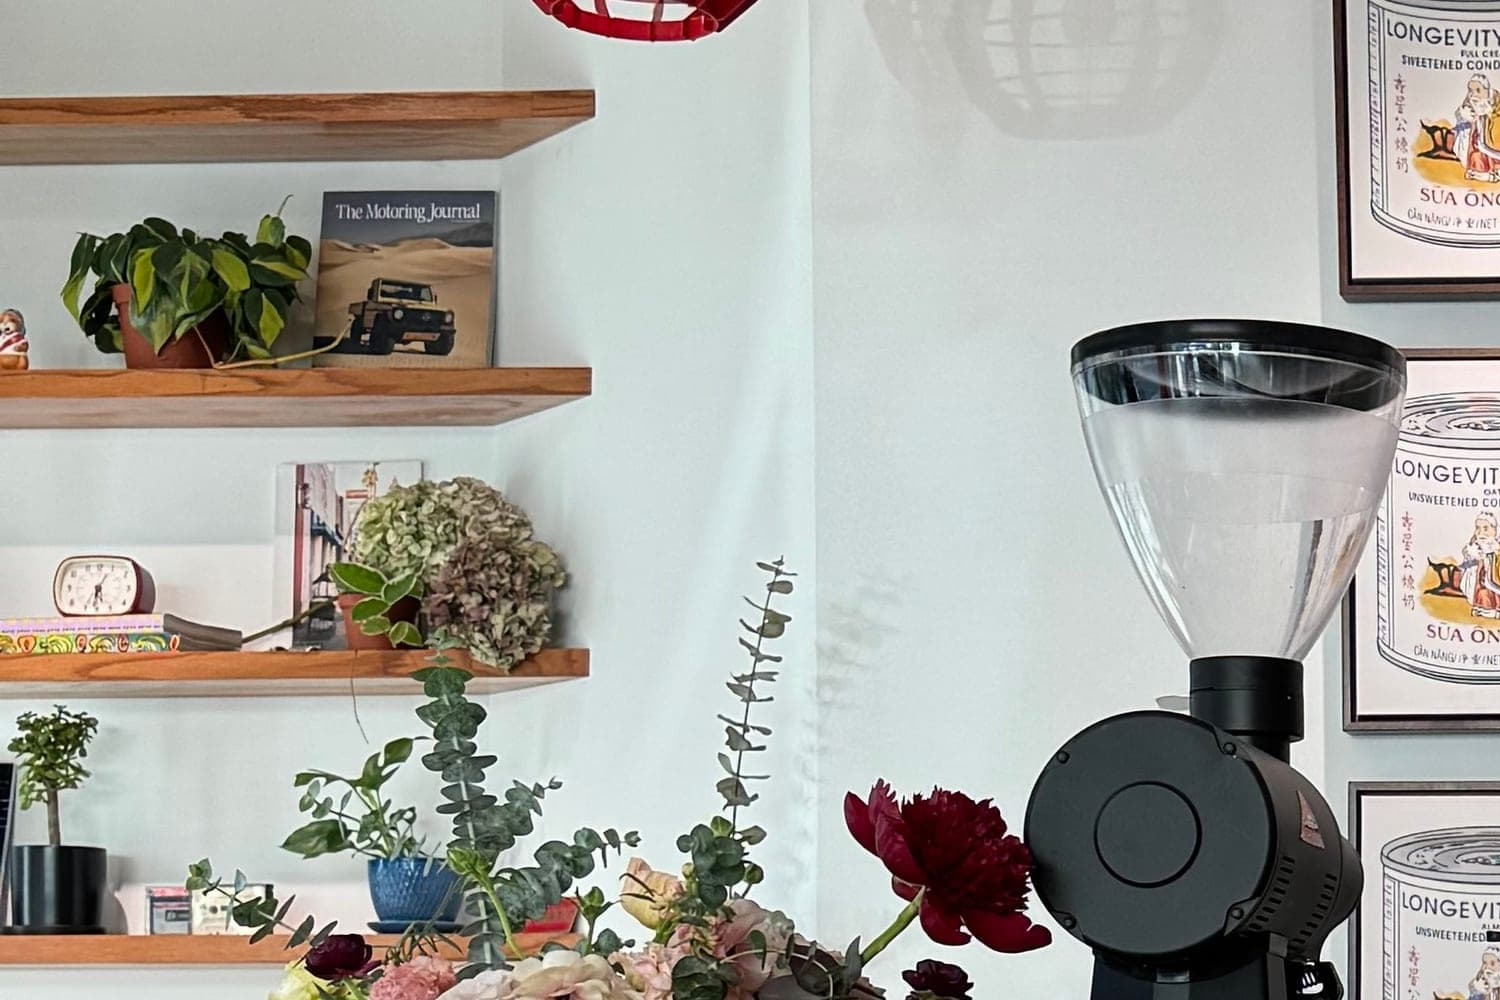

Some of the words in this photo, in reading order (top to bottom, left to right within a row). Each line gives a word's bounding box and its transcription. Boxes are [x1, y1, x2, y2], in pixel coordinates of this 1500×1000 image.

[1402, 55, 1462, 70] SWEETENED
[336, 203, 362, 219] The
[366, 203, 426, 223] Motoring
[427, 203, 480, 222] Journal
[1409, 492, 1478, 508] UNSWEETENED
[1416, 925, 1486, 943] UNSWEETENED
